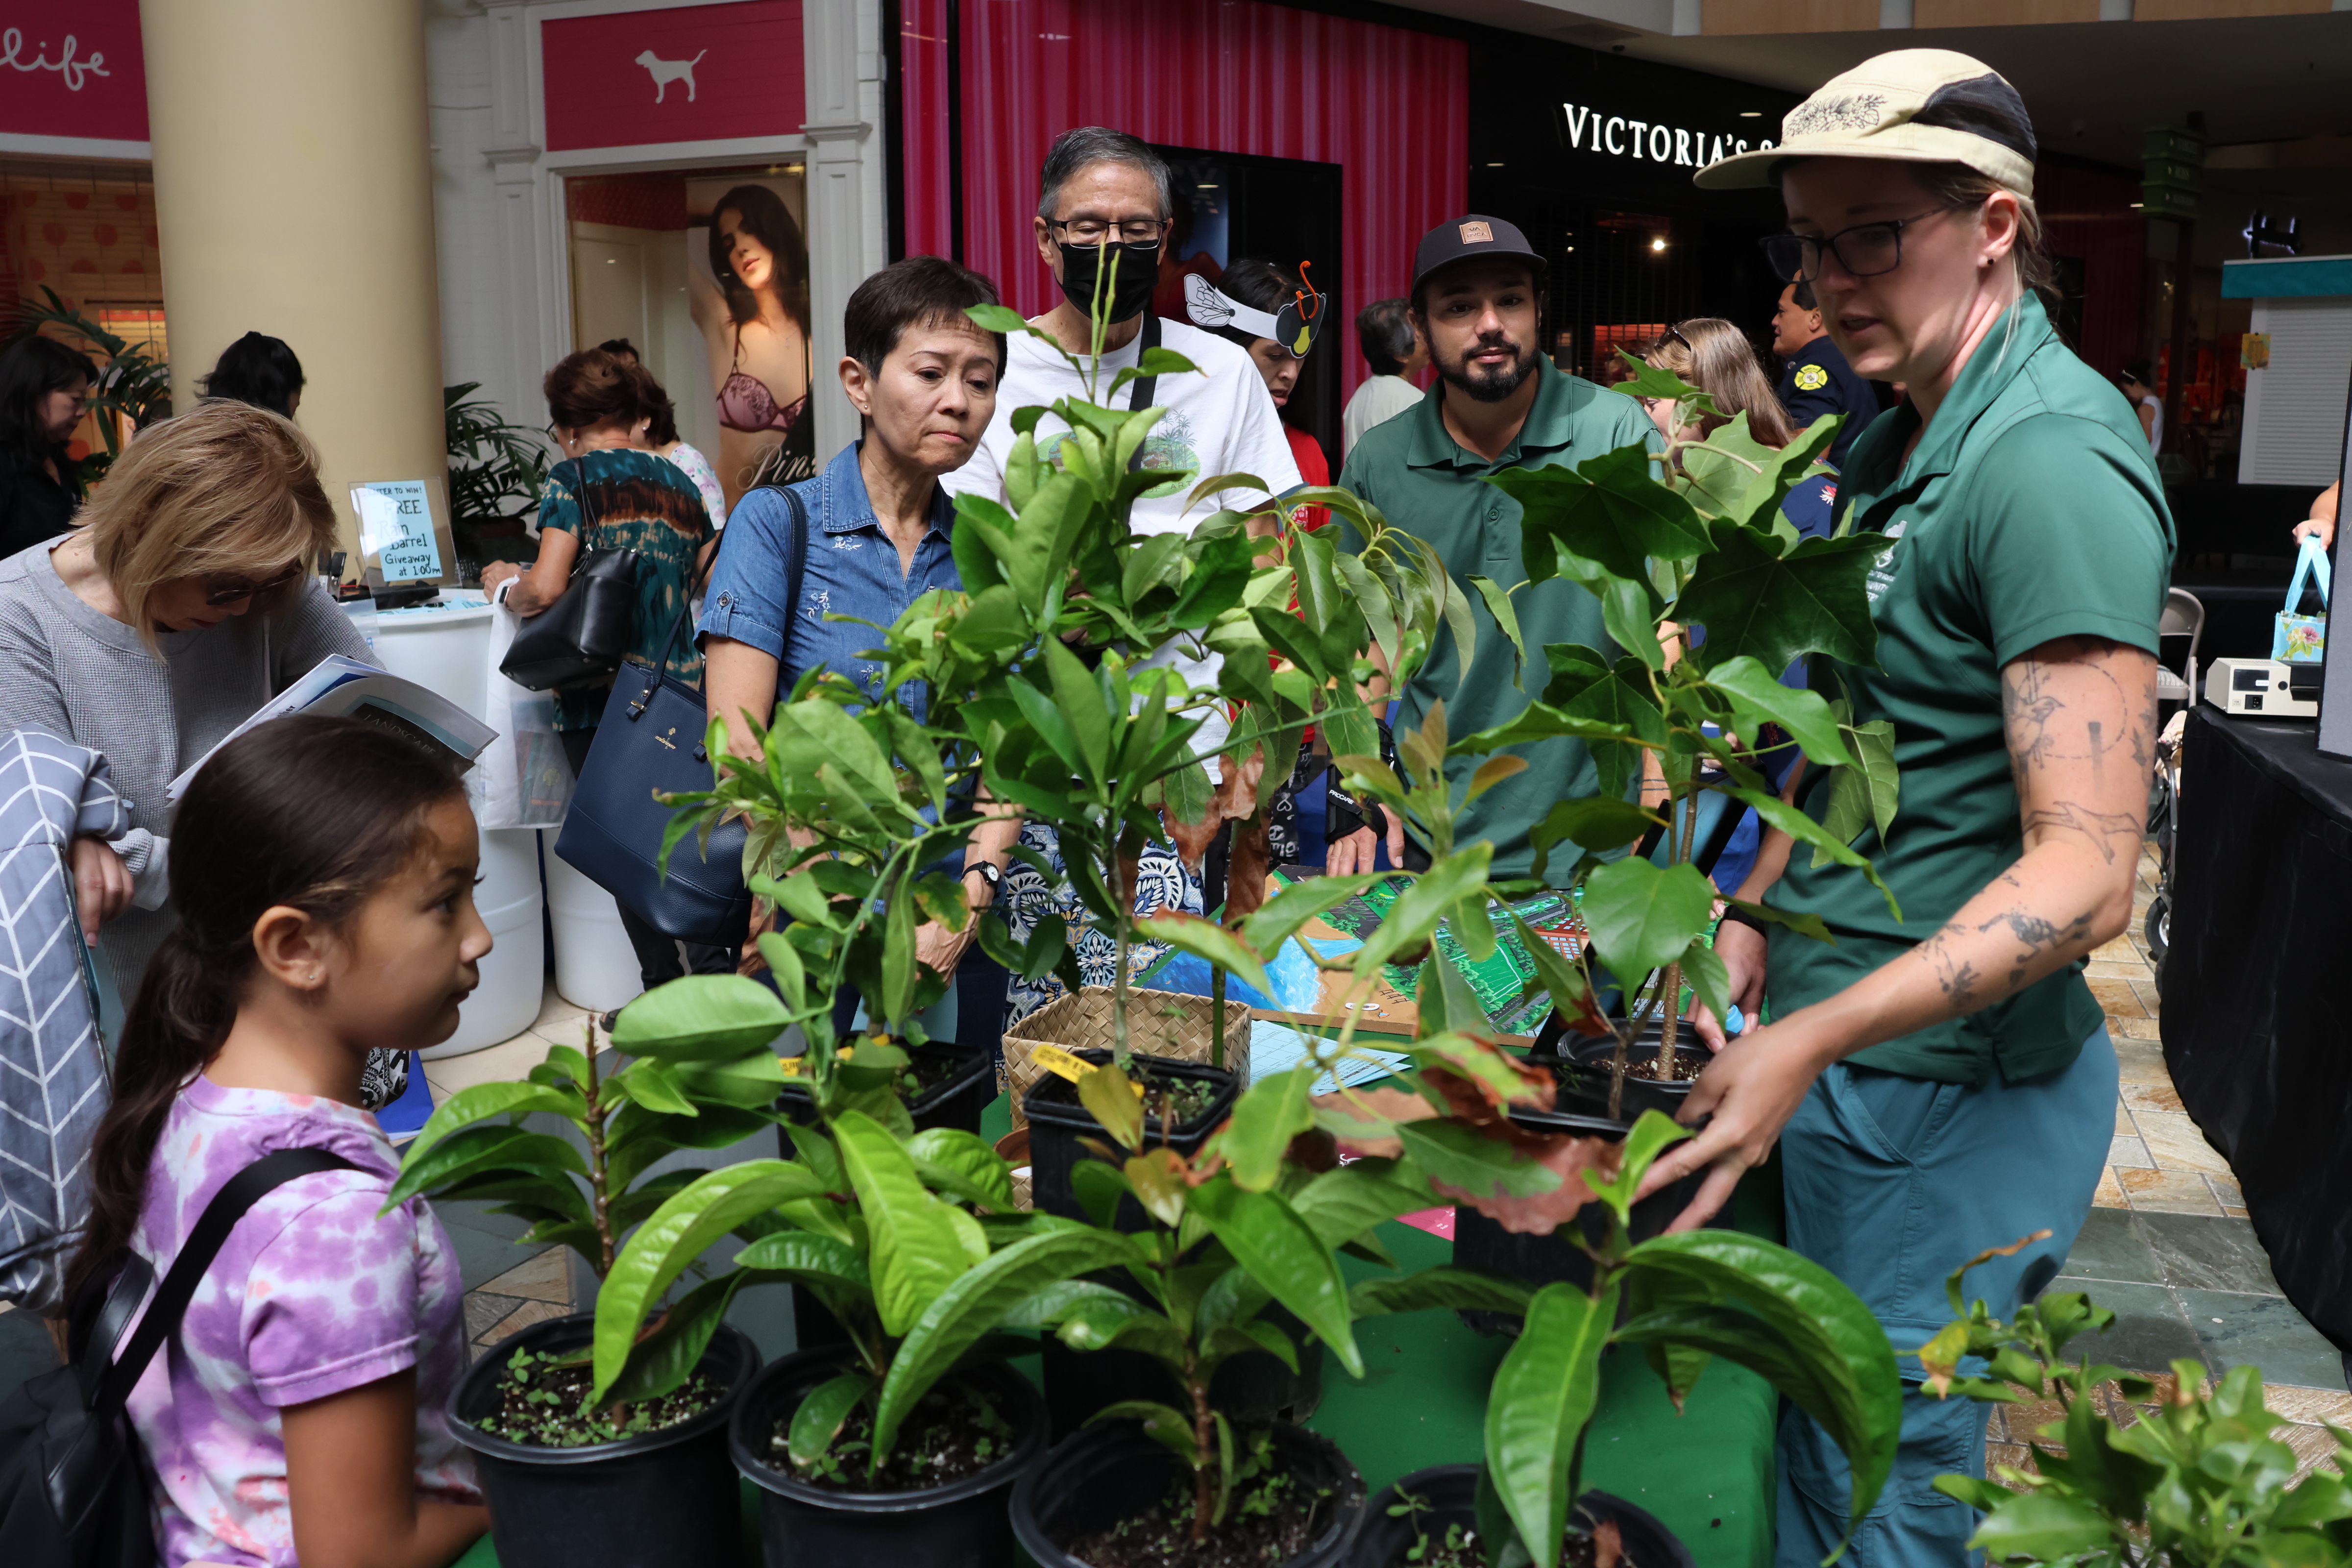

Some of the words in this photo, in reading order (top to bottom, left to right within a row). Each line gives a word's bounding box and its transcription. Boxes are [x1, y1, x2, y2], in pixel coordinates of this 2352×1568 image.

[0, 28, 110, 92] life
[1170, 480, 1192, 490] ART
[384, 499, 422, 515] FREE
[377, 520, 410, 539] Rain
[390, 534, 428, 550] Barrel
[385, 554, 431, 565] Giveaway
[398, 566, 407, 577] at
[1328, 789, 1354, 805] PROCARE
